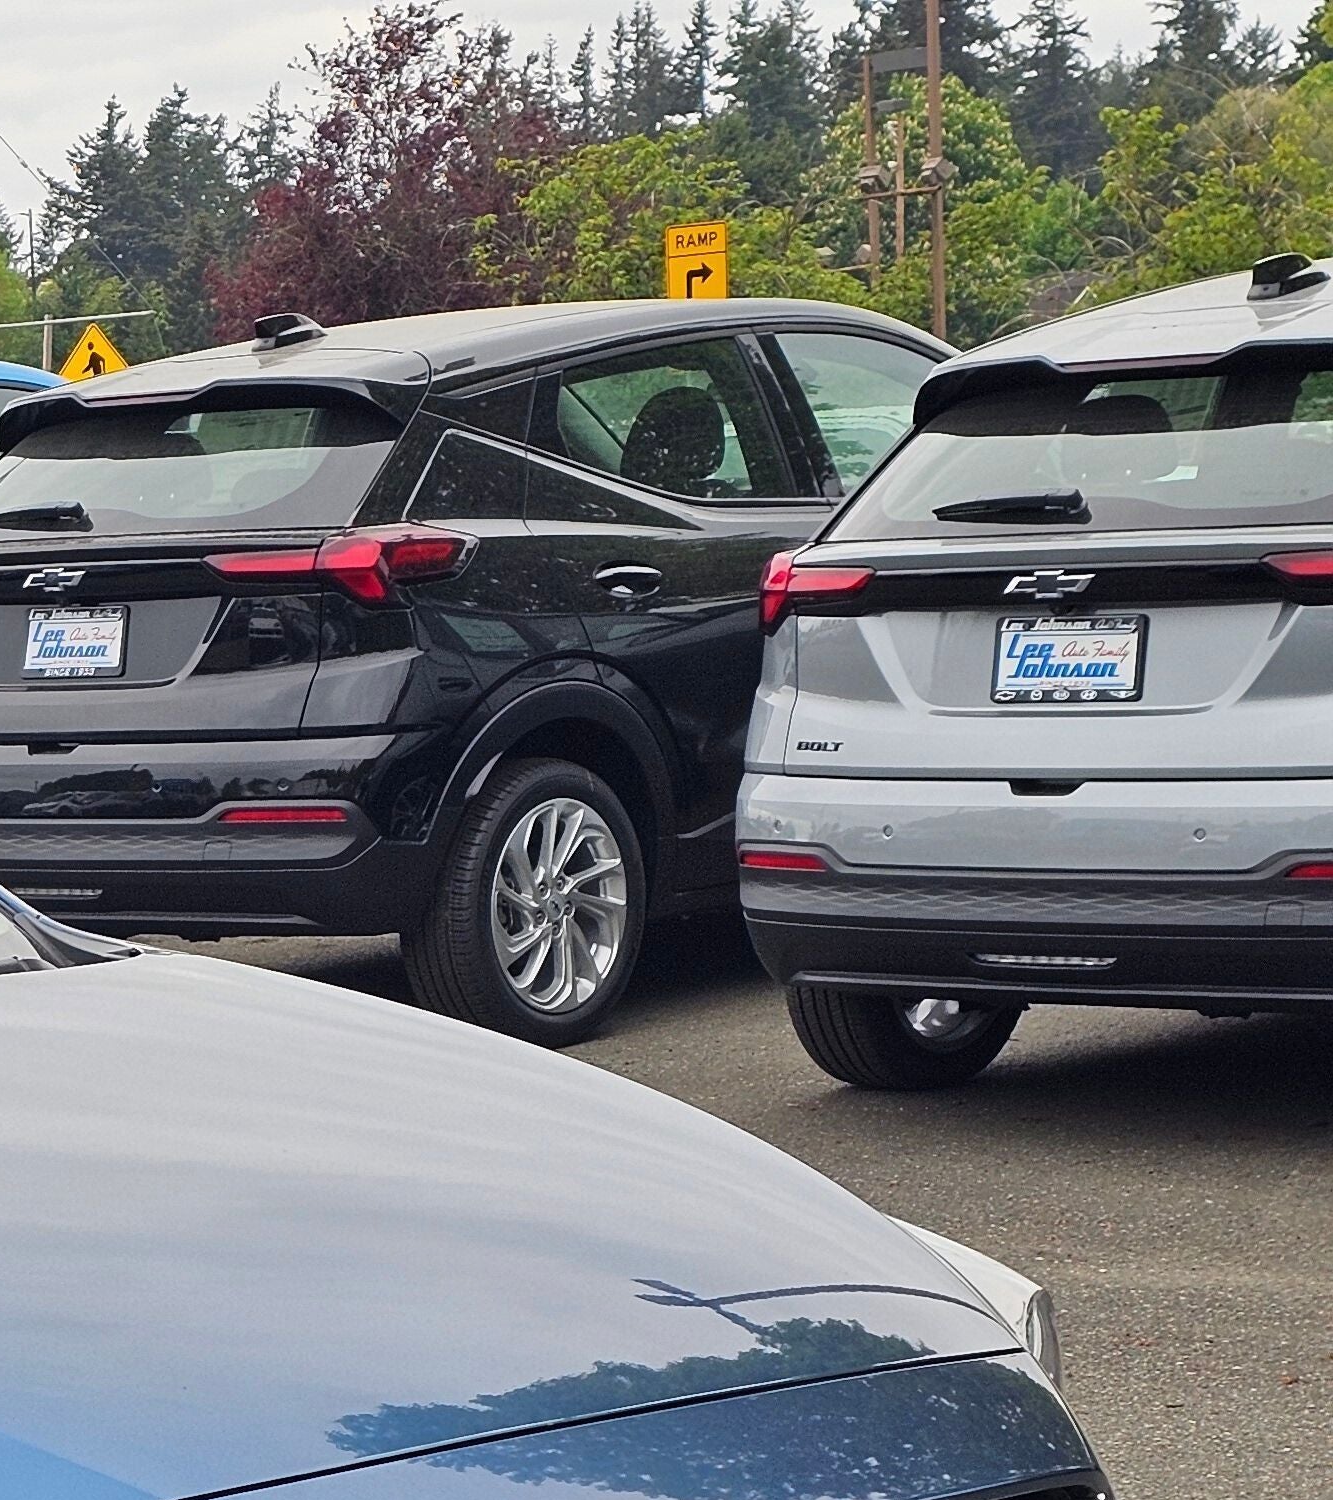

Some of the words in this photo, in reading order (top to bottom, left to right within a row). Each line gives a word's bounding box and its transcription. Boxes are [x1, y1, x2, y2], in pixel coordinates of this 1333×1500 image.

[675, 231, 718, 249] RAMP
[33, 622, 66, 642] Lee
[32, 641, 109, 659] Johnson
[1006, 633, 1056, 658] Lee
[1006, 657, 1120, 678] Johnson
[796, 741, 844, 752] BOLT
